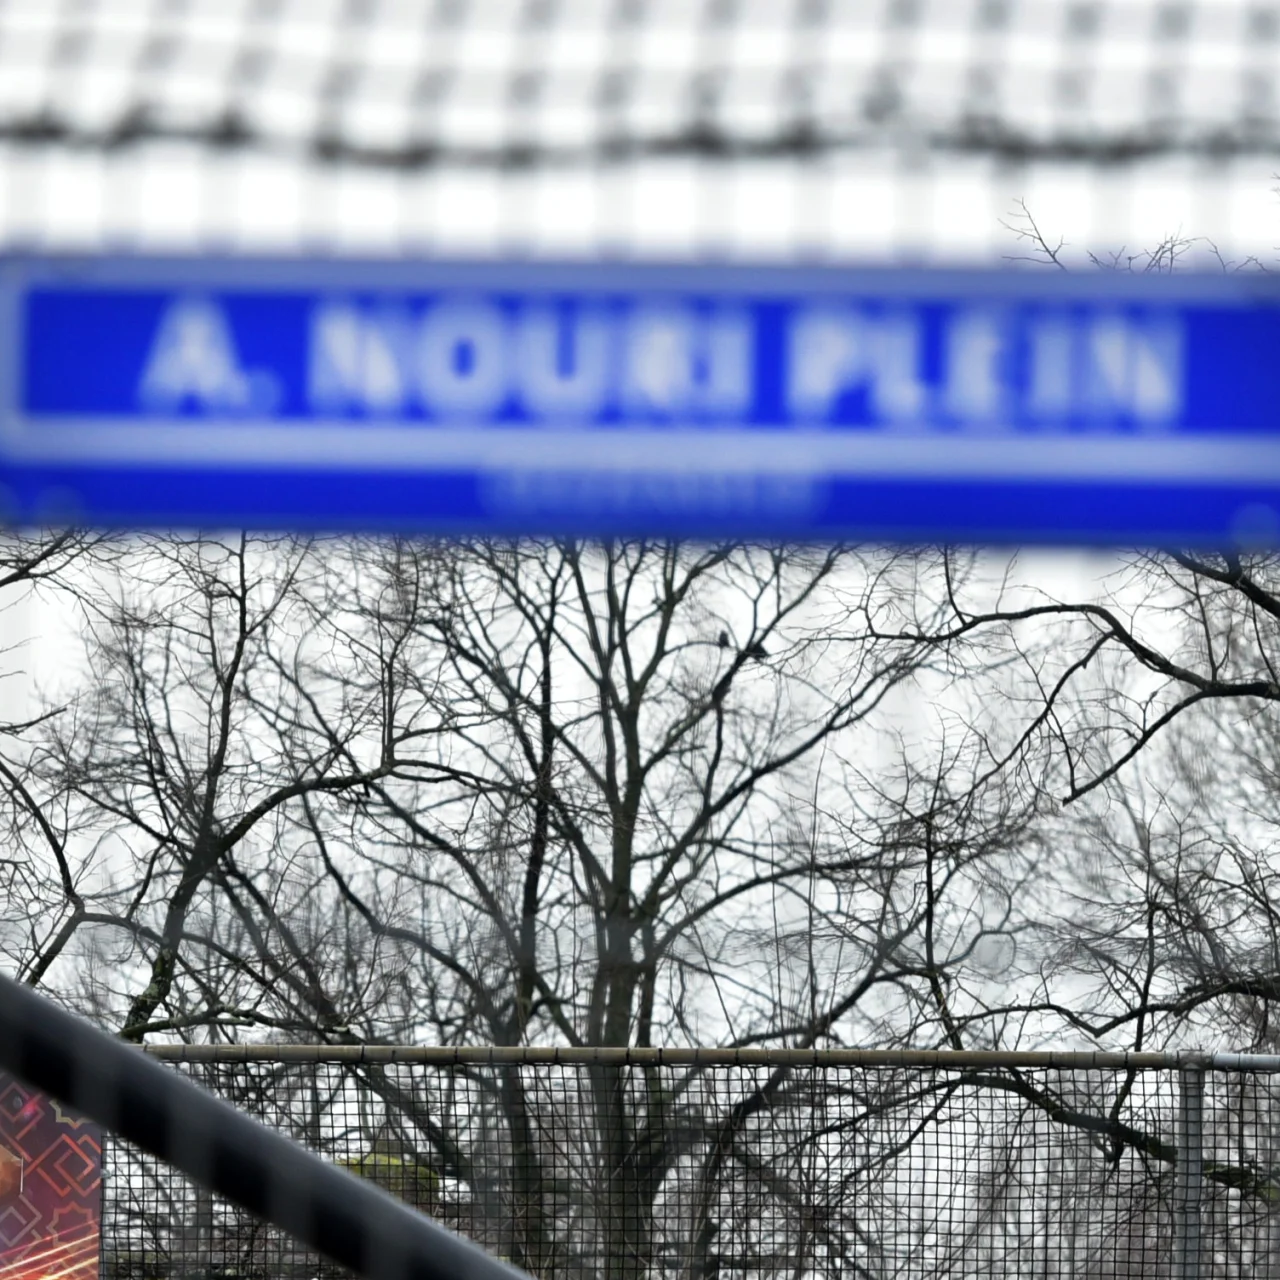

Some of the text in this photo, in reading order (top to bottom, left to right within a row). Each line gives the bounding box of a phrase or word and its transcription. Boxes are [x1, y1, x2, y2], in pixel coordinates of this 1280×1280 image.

[137, 292, 1186, 434] A. NOURI PLEIN
